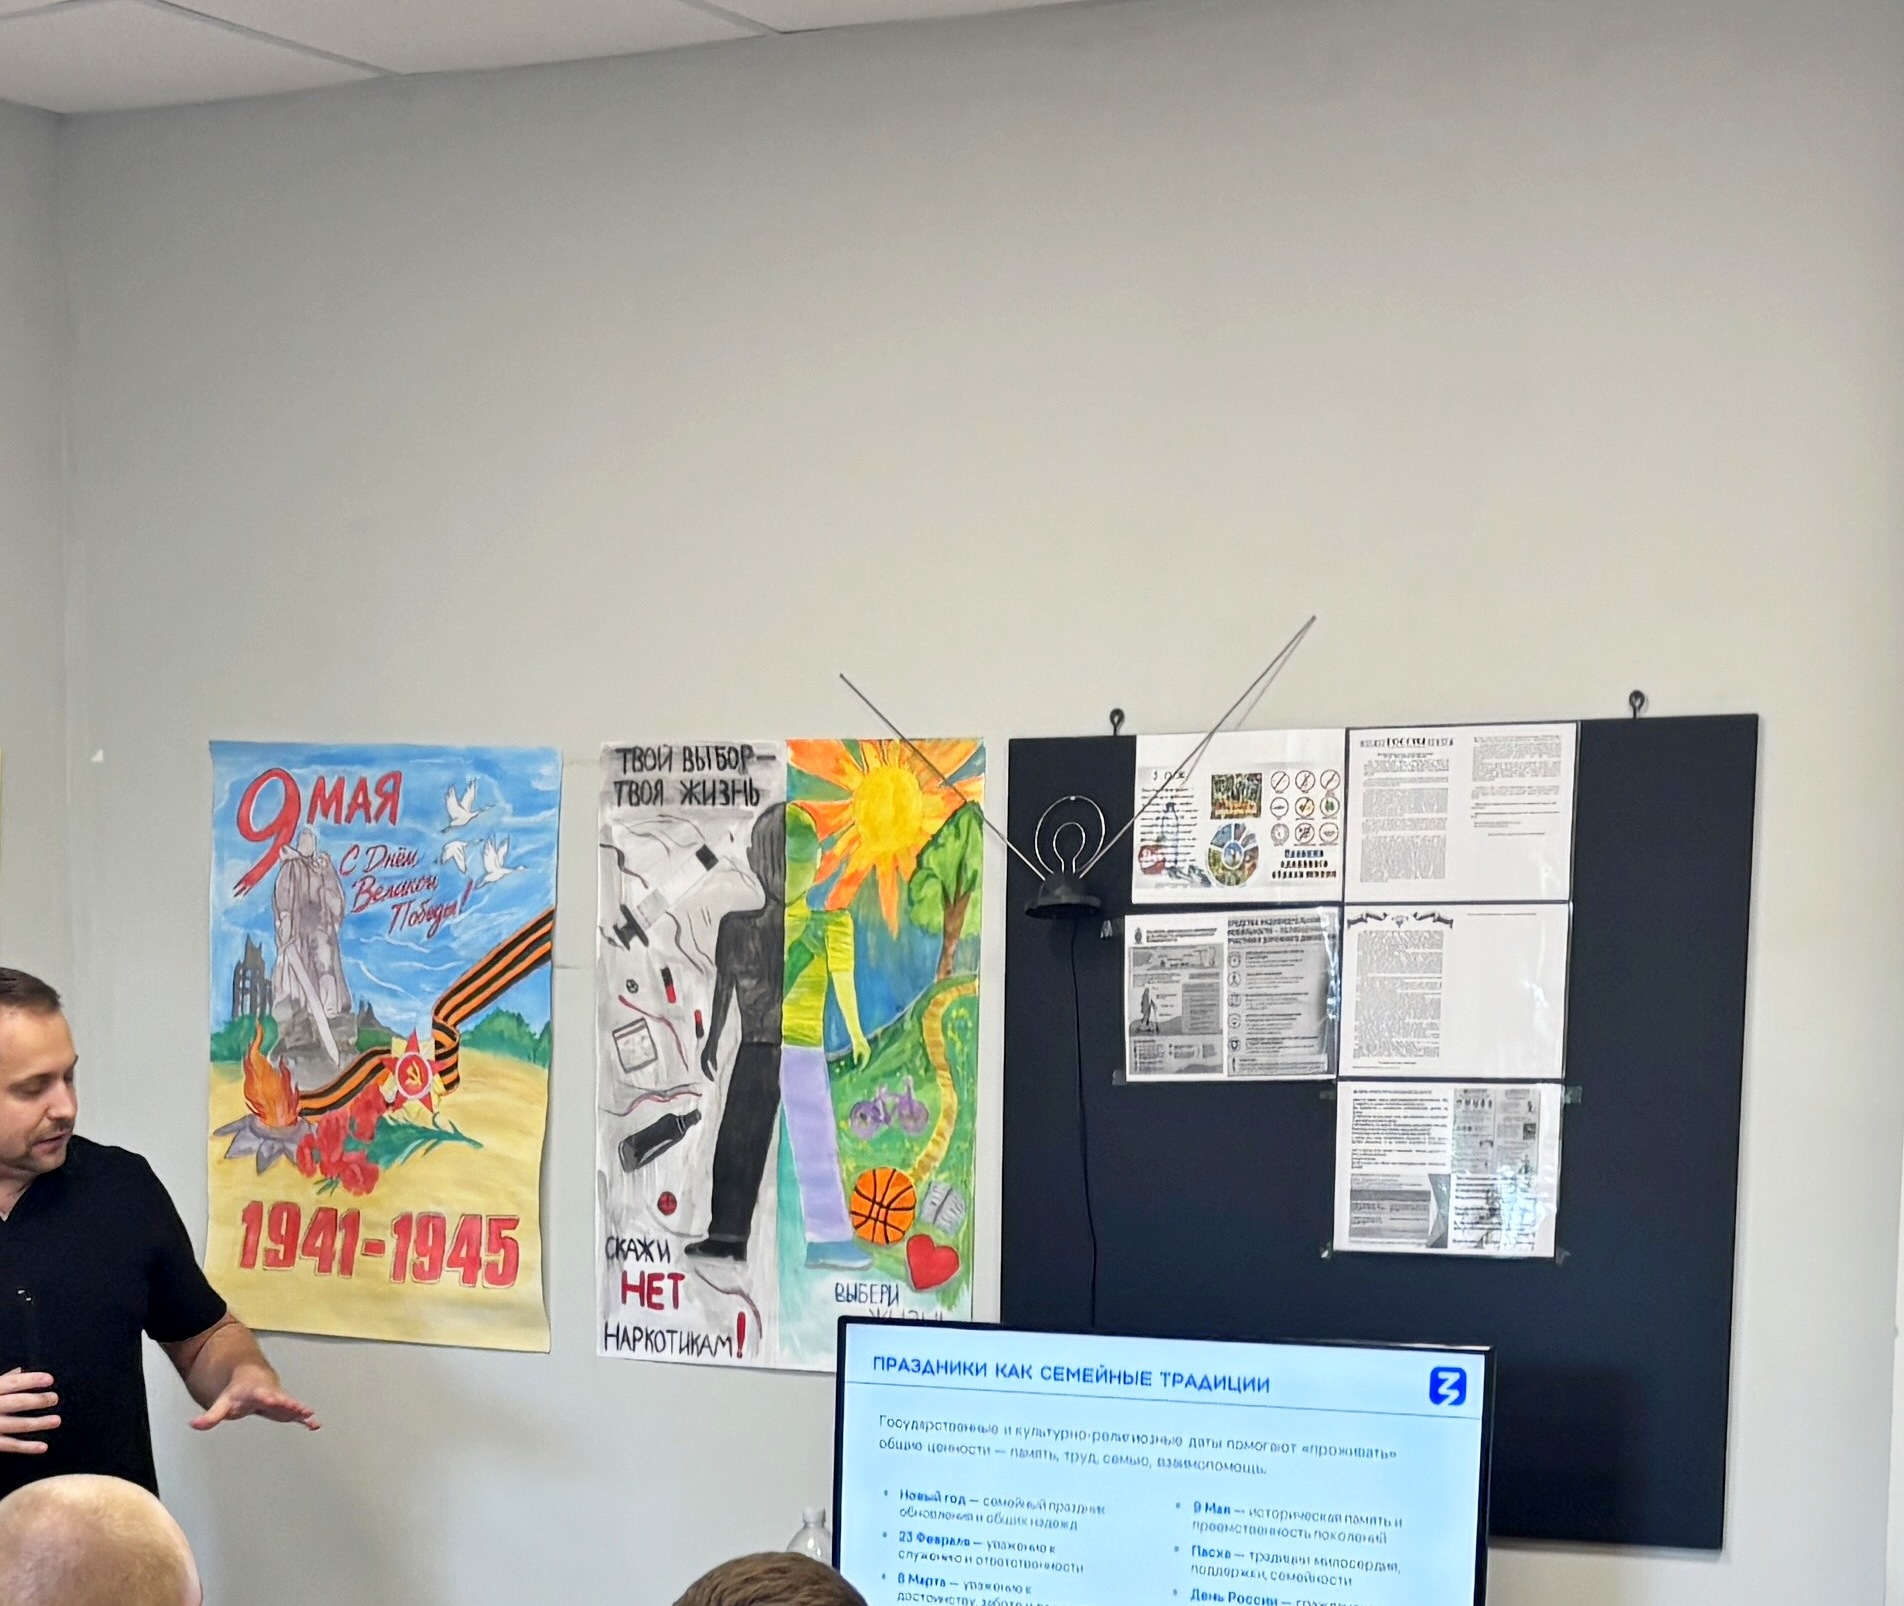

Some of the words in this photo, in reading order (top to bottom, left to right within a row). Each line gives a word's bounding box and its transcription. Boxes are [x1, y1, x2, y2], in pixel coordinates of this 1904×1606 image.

[614, 744, 673, 775] ТВОЙ
[614, 778, 664, 807] ТВОЯ
[680, 776, 761, 807] ЖИЗНЬ
[234, 768, 301, 896] 9
[306, 771, 402, 827] МАЯ
[339, 844, 360, 876] С
[239, 1200, 520, 1291] 1941-1945
[605, 1236, 671, 1264] СКАЖИ
[621, 1270, 686, 1311] НЕТ
[835, 1282, 899, 1307] ВЫБЕРИ
[873, 1356, 988, 1377] ПРАЗДНИКИ
[995, 1362, 1033, 1381] КАК
[1040, 1364, 1153, 1388] СЕМЕЙНЫЕ
[1160, 1371, 1271, 1395] ТРАДИЦИИ
[900, 1488, 942, 1503] Новый
[899, 1531, 914, 1543] 23
[1190, 1588, 1225, 1603] День
[1228, 1591, 1279, 1606] России
